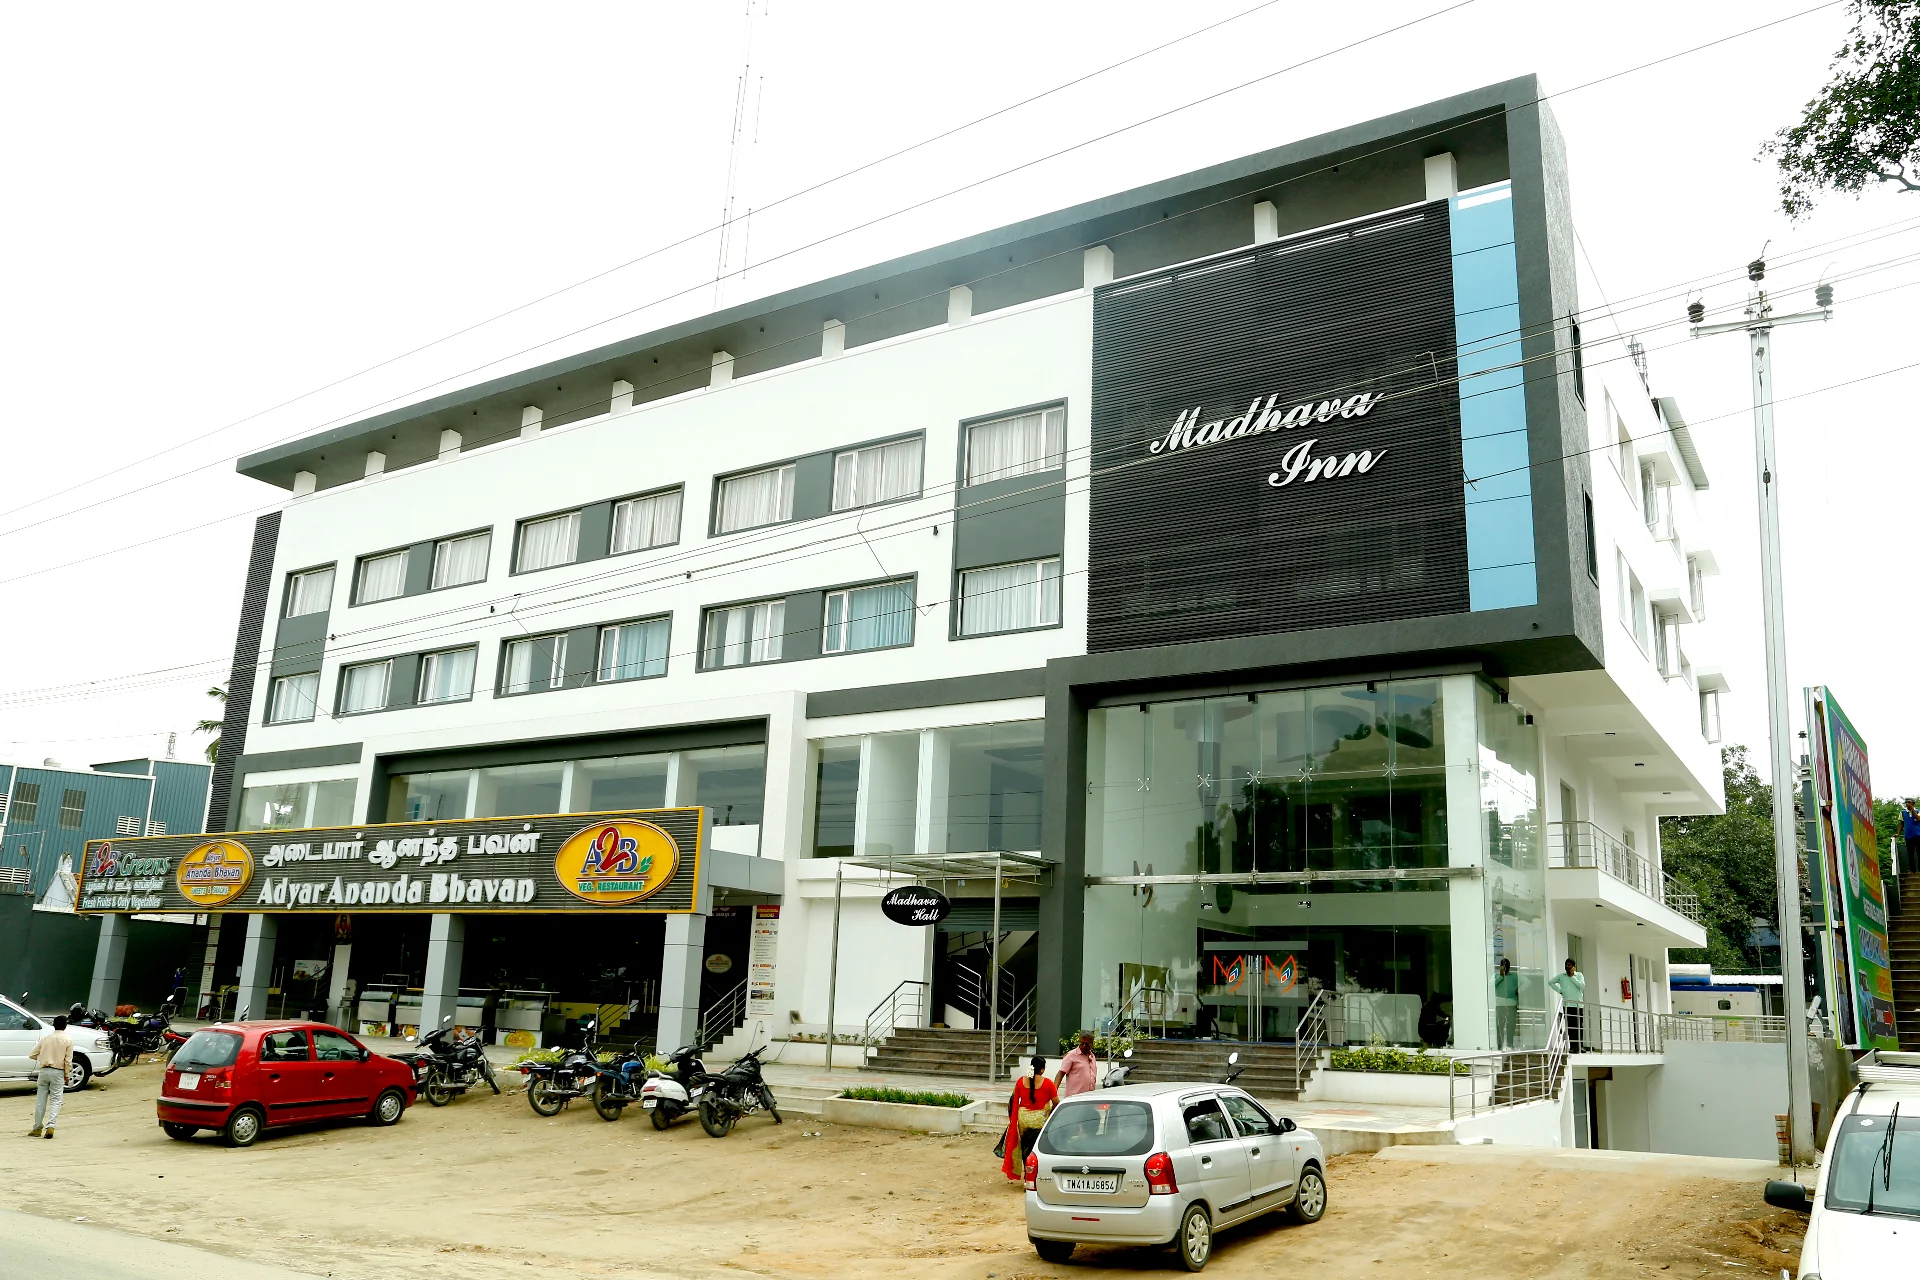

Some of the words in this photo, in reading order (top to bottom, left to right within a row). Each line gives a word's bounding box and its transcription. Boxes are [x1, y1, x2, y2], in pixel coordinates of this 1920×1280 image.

[1150, 393, 1385, 454] Madhava
[1268, 439, 1388, 487] Inn
[262, 832, 366, 867] அடையார்
[368, 829, 460, 869] ஆனந்த
[467, 823, 542, 855] பவன்
[580, 826, 639, 874] A2B
[87, 842, 121, 877] A2B
[120, 853, 172, 876] Greens
[185, 865, 212, 880] Ananda
[213, 865, 241, 880] Bhavan
[257, 877, 328, 910] Adyar
[325, 874, 425, 904] Ananda
[429, 873, 537, 904] Bhavan
[578, 881, 594, 892] VEG.
[597, 880, 644, 892] RESTAURANT
[82, 897, 97, 909] Fresh
[97, 896, 112, 908] Fruits
[131, 895, 161, 910] Vegetables
[886, 893, 939, 906] Madhava
[912, 908, 939, 921] Hall
[1067, 1179, 1114, 1190] TN41AJ6854
